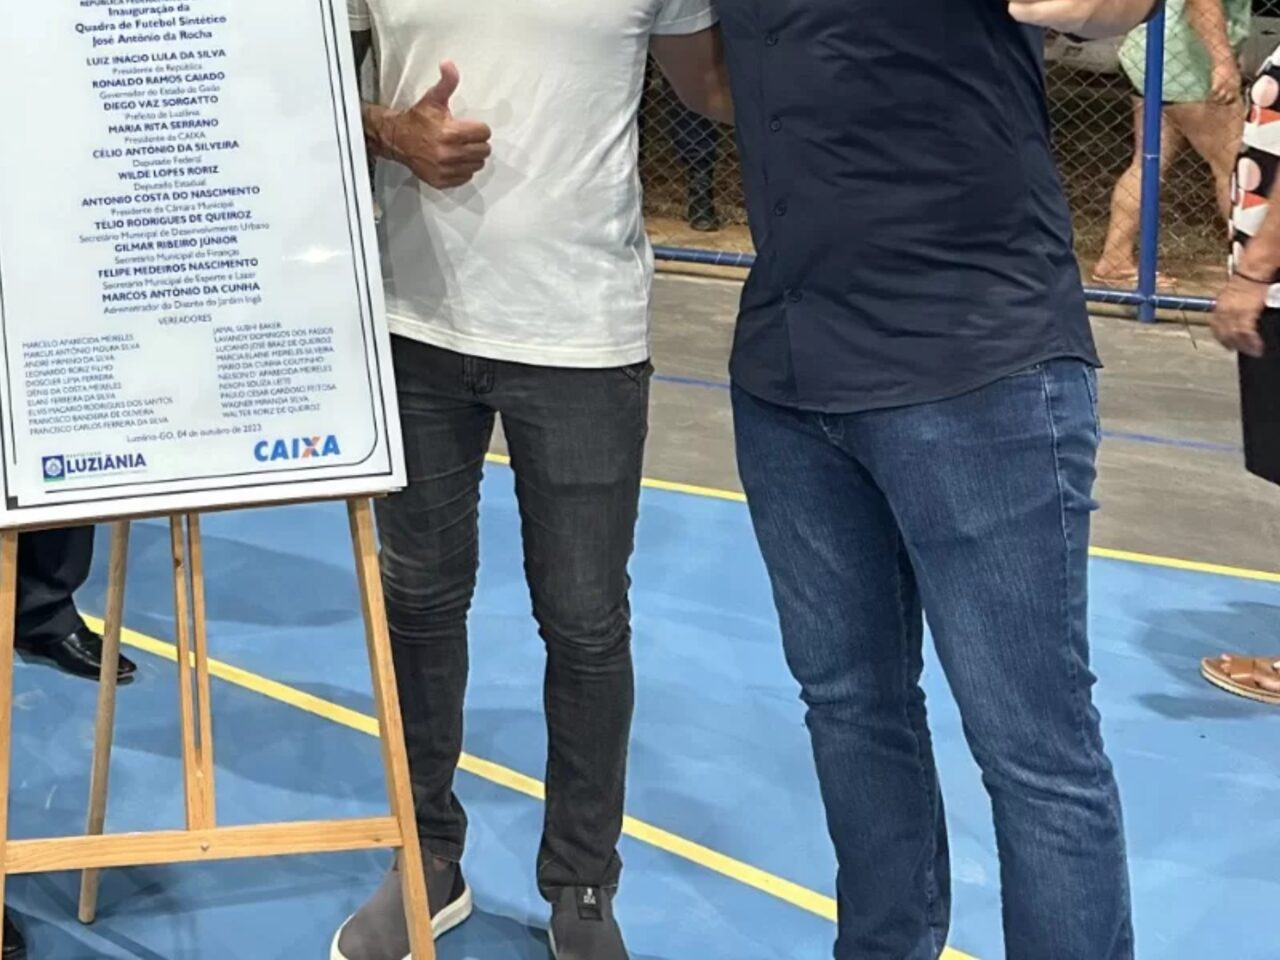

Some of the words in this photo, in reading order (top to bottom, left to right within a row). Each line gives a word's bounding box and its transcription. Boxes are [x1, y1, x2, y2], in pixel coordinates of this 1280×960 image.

[108, 3, 175, 19] Inauguração
[176, 3, 190, 12] da
[75, 20, 116, 34] Quadra
[118, 20, 132, 30] de
[135, 17, 176, 29] Futebol
[178, 13, 227, 26] Sintético
[92, 35, 115, 48] José
[117, 32, 161, 44] Antônio
[162, 31, 177, 41] da
[179, 28, 212, 40] Rocha
[86, 56, 110, 66] LUIZ
[151, 52, 178, 62] LULA
[179, 50, 195, 60] DA
[197, 49, 226, 59] SILVA
[92, 77, 144, 89] RONALDO
[145, 74, 183, 85] RAMOS
[184, 71, 225, 83] CAIADO
[103, 100, 137, 111] DIEGO
[138, 99, 160, 109] VAZ
[162, 94, 219, 107] SORGATTO
[108, 123, 142, 134] MARIA
[144, 122, 169, 132] RITA
[170, 118, 219, 130] SERRANO
[177, 143, 193, 153] DA
[194, 140, 239, 152] SILVEIRA
[118, 169, 151, 181] WILDE
[153, 167, 185, 178] LOPES
[187, 165, 219, 176] RORIZ
[81, 195, 133, 207] ANTONIO
[134, 192, 170, 203] COSTA
[172, 191, 189, 201] DO
[190, 185, 260, 199] NASCIMENTO
[126, 214, 187, 228] RODRIGUES
[188, 213, 203, 223] DE
[204, 209, 252, 224] QUEIROZ
[114, 241, 154, 253] GILMAR
[156, 238, 198, 250] RIBEIRO
[98, 267, 131, 278] FELIPE
[133, 263, 187, 276] MEDEIROS
[188, 257, 259, 272] NASCIMENTO
[102, 290, 148, 303] MARCOS
[202, 284, 219, 295] DA
[220, 282, 260, 294] CUNHA
[253, 433, 341, 462] CAIXA
[65, 451, 147, 474] LUZIÂNIA
